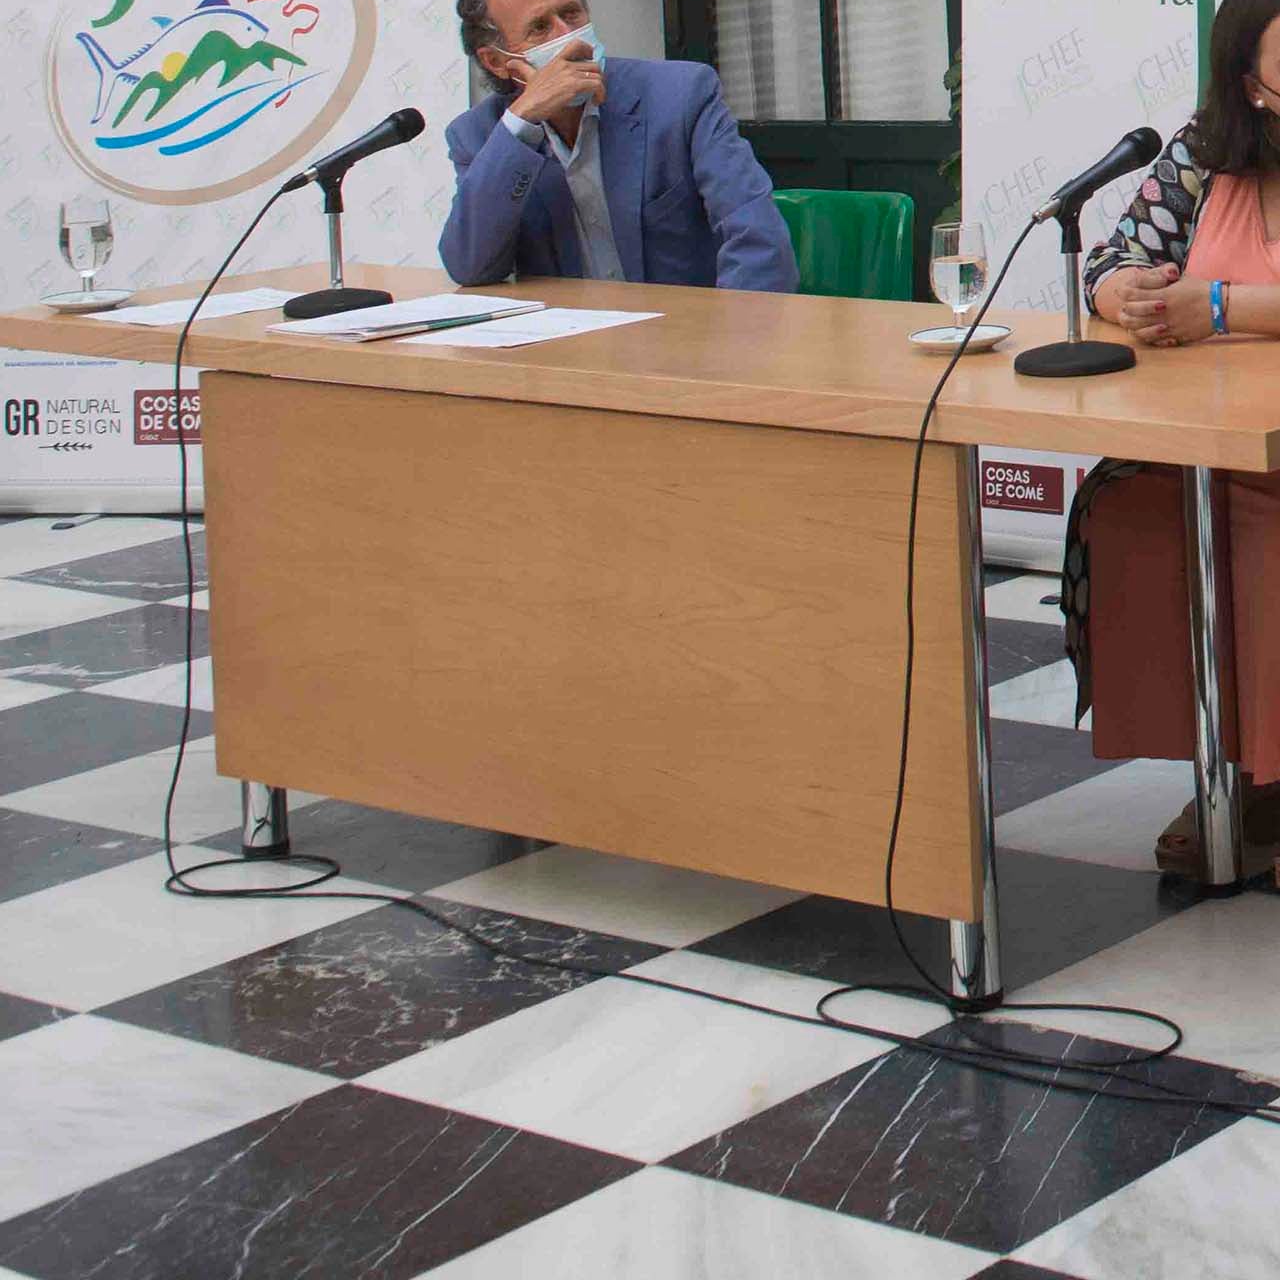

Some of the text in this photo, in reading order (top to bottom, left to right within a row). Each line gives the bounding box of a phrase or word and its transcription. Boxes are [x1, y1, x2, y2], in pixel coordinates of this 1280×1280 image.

[46, 398, 121, 415] NATURAL
[140, 395, 200, 412] COSAS
[4, 398, 40, 437] GR
[140, 414, 164, 431] DE
[46, 418, 122, 436] DESIGN
[986, 467, 1030, 484] COSAS
[986, 483, 1044, 501] DE COMÉ
